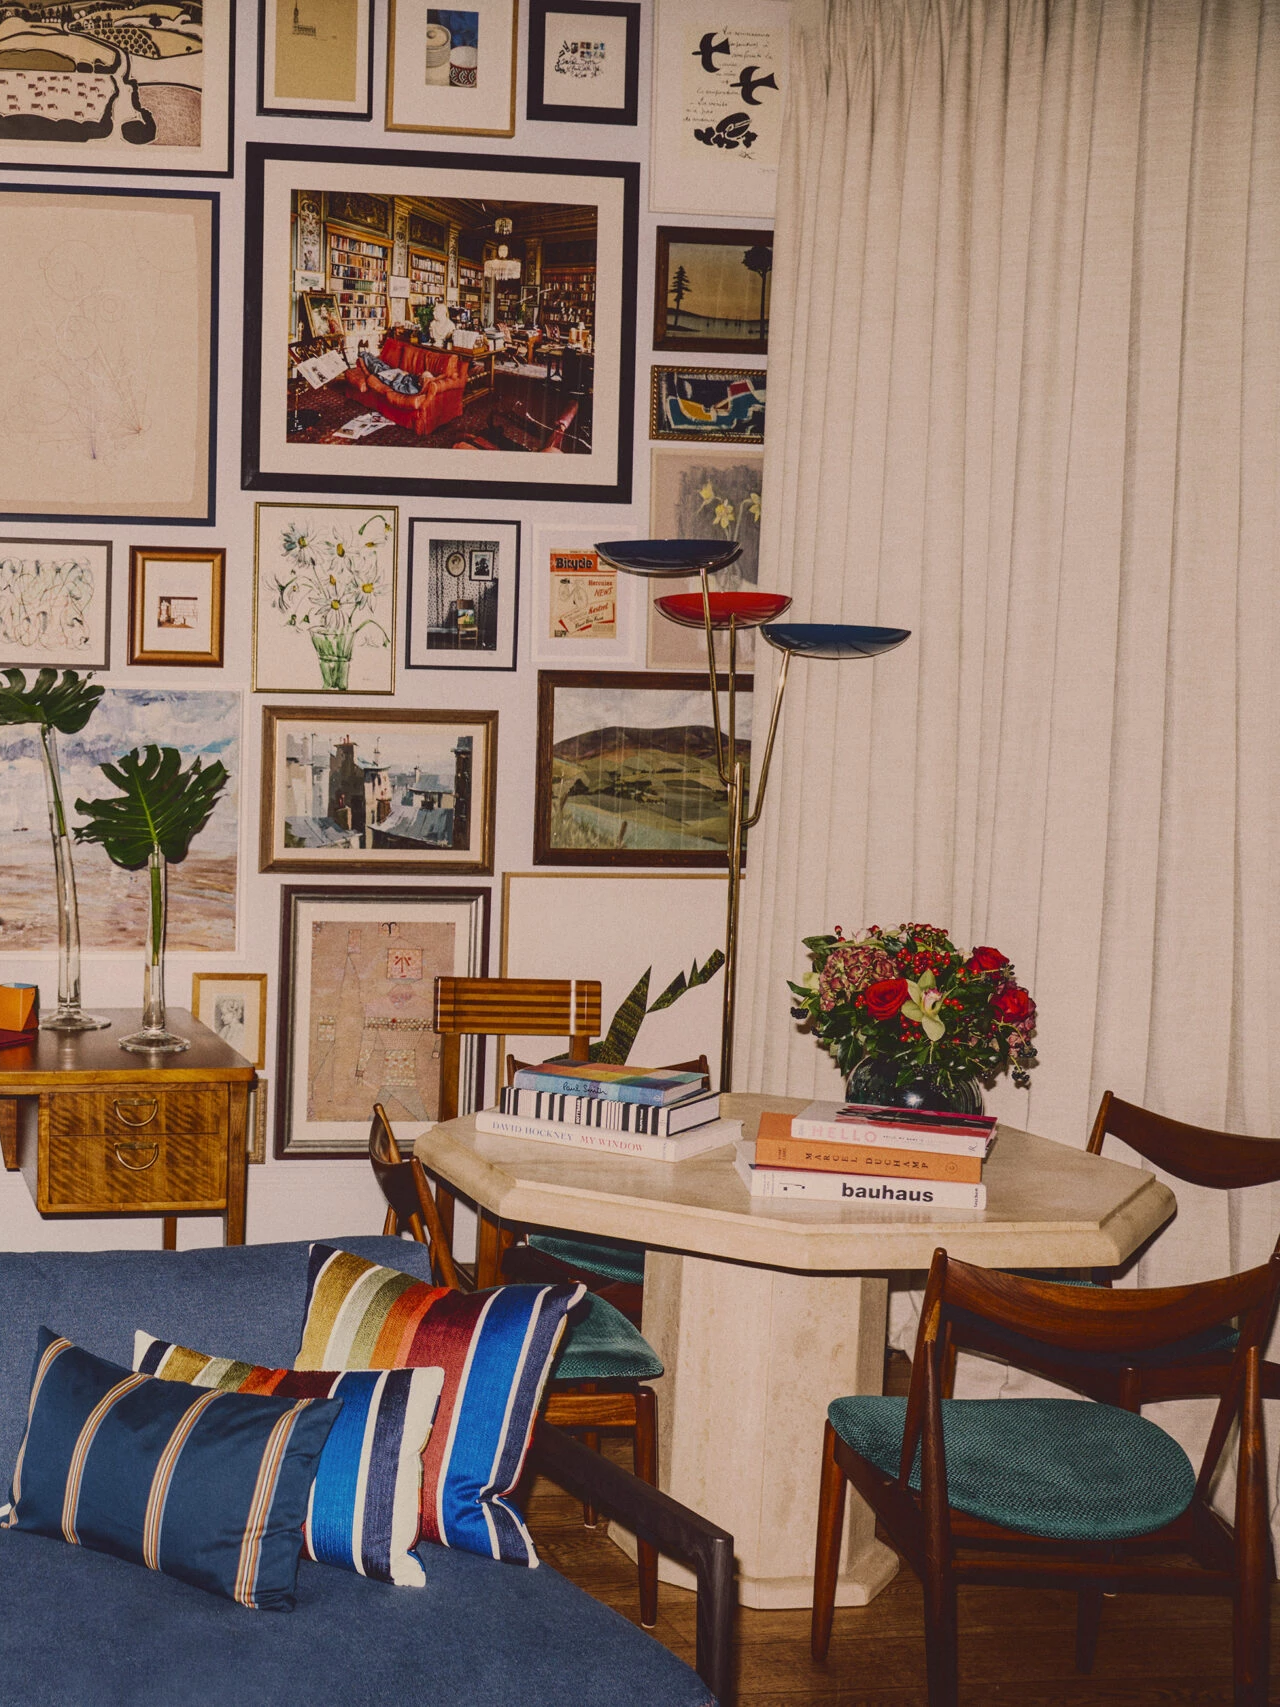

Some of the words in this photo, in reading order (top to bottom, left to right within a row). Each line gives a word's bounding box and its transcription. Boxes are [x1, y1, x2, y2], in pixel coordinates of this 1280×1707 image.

[555, 557, 593, 571] Bicycle
[562, 1081, 580, 1092] Paul
[583, 1084, 608, 1096] Smith
[492, 1121, 521, 1132] DAVID
[525, 1125, 573, 1141] HOCKNEY
[580, 1135, 596, 1145] MY
[599, 1138, 645, 1151] WINDOW
[812, 1125, 878, 1143] HELLO
[805, 1152, 858, 1163] MARCEL
[865, 1157, 929, 1169] DUCHAMP
[841, 1182, 934, 1203] bauhaus
